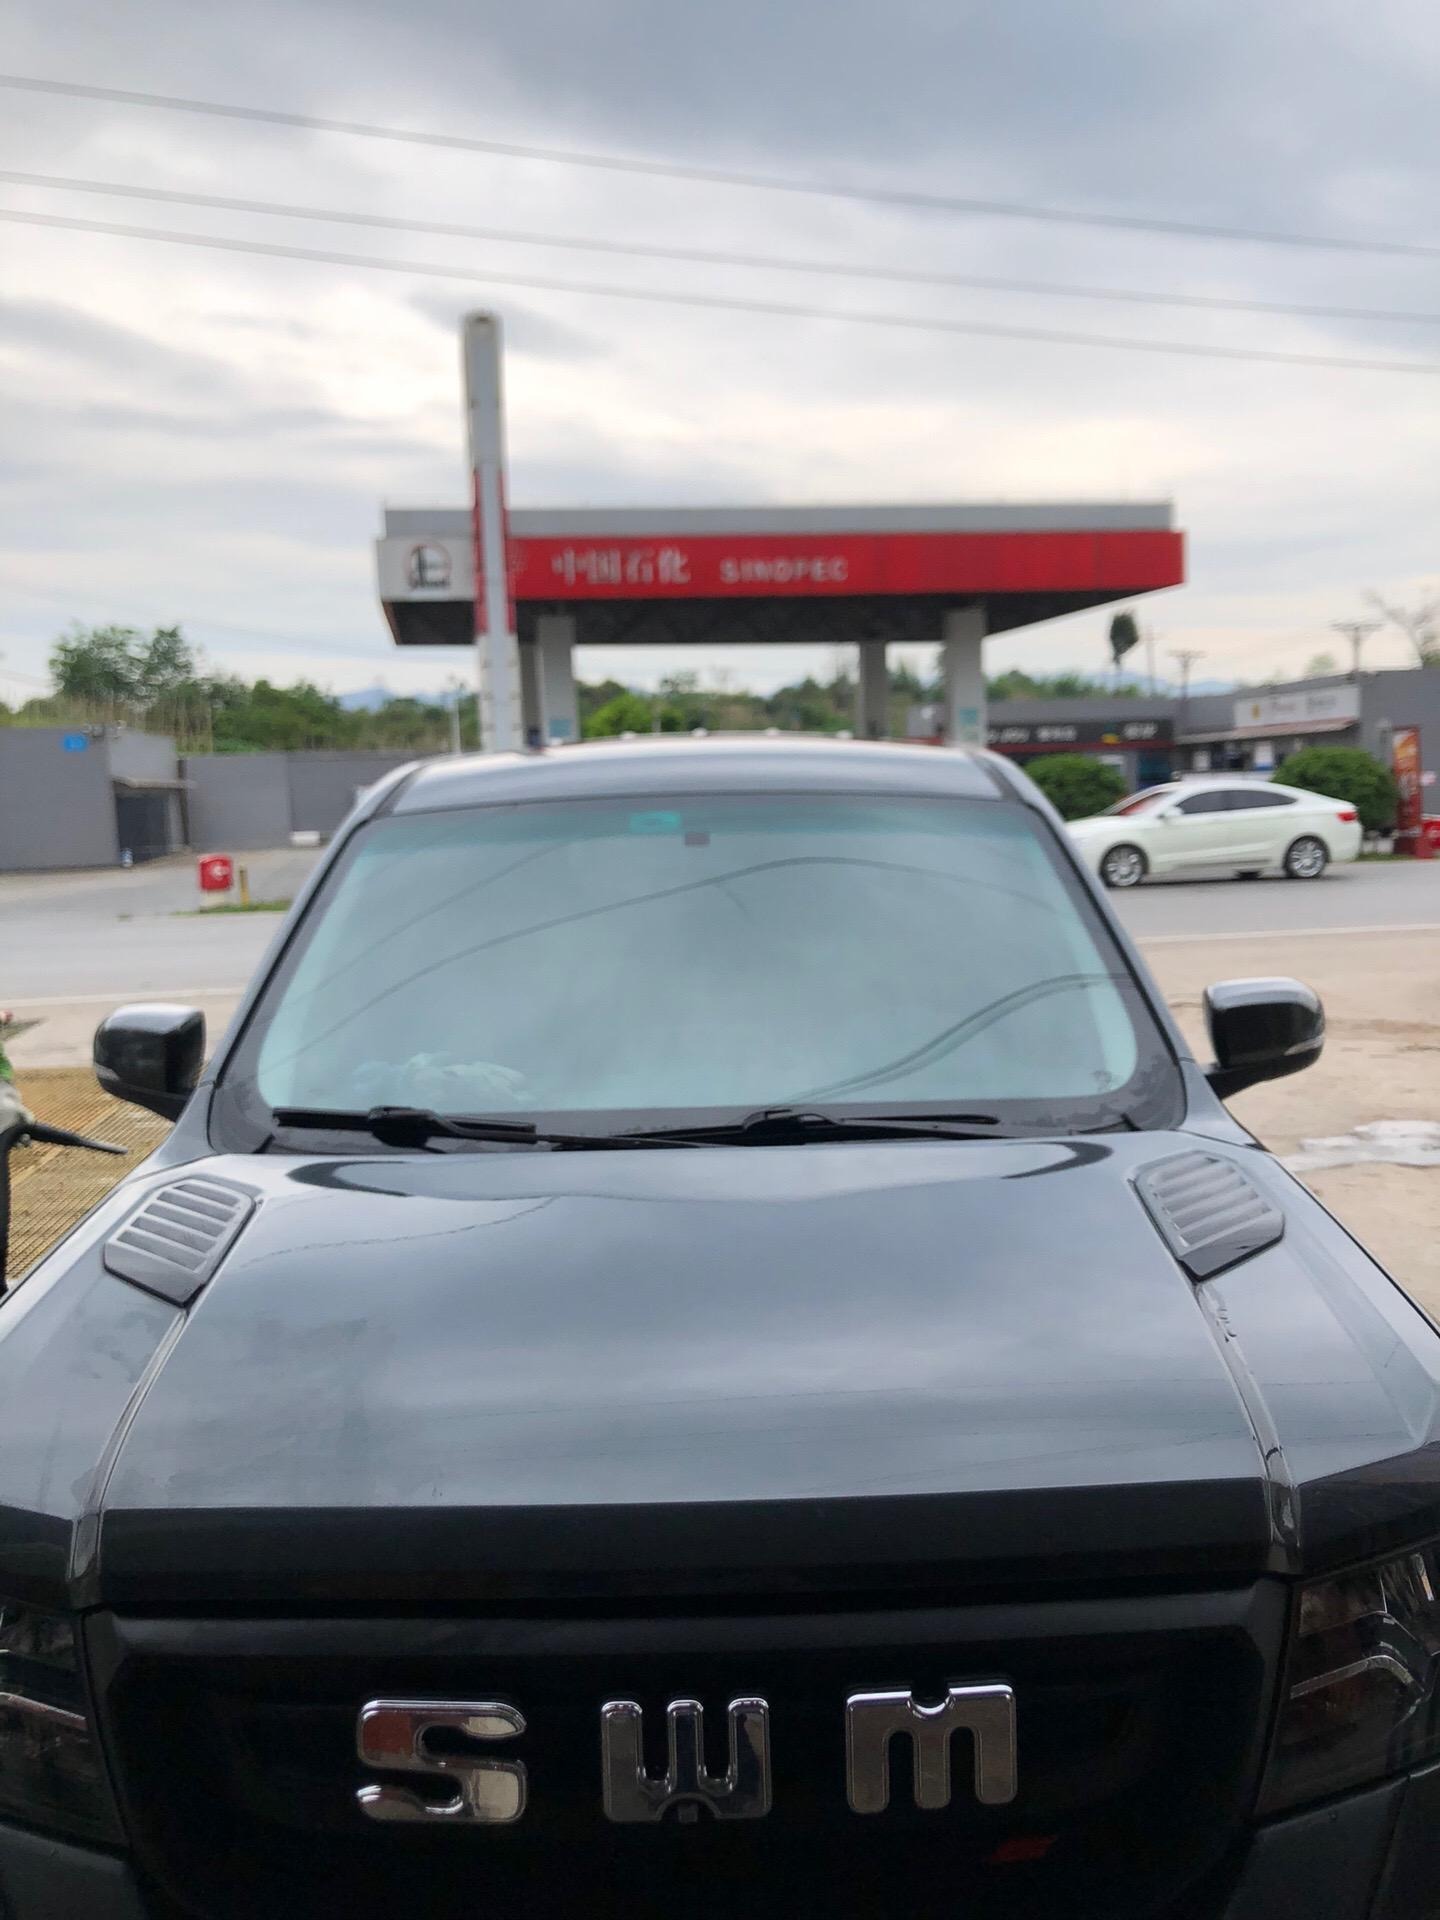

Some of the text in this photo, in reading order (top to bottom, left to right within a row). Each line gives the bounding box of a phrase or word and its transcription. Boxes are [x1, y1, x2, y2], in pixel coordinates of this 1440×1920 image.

[551, 547, 690, 586] 中国石化
[720, 556, 848, 583] SINOPEC
